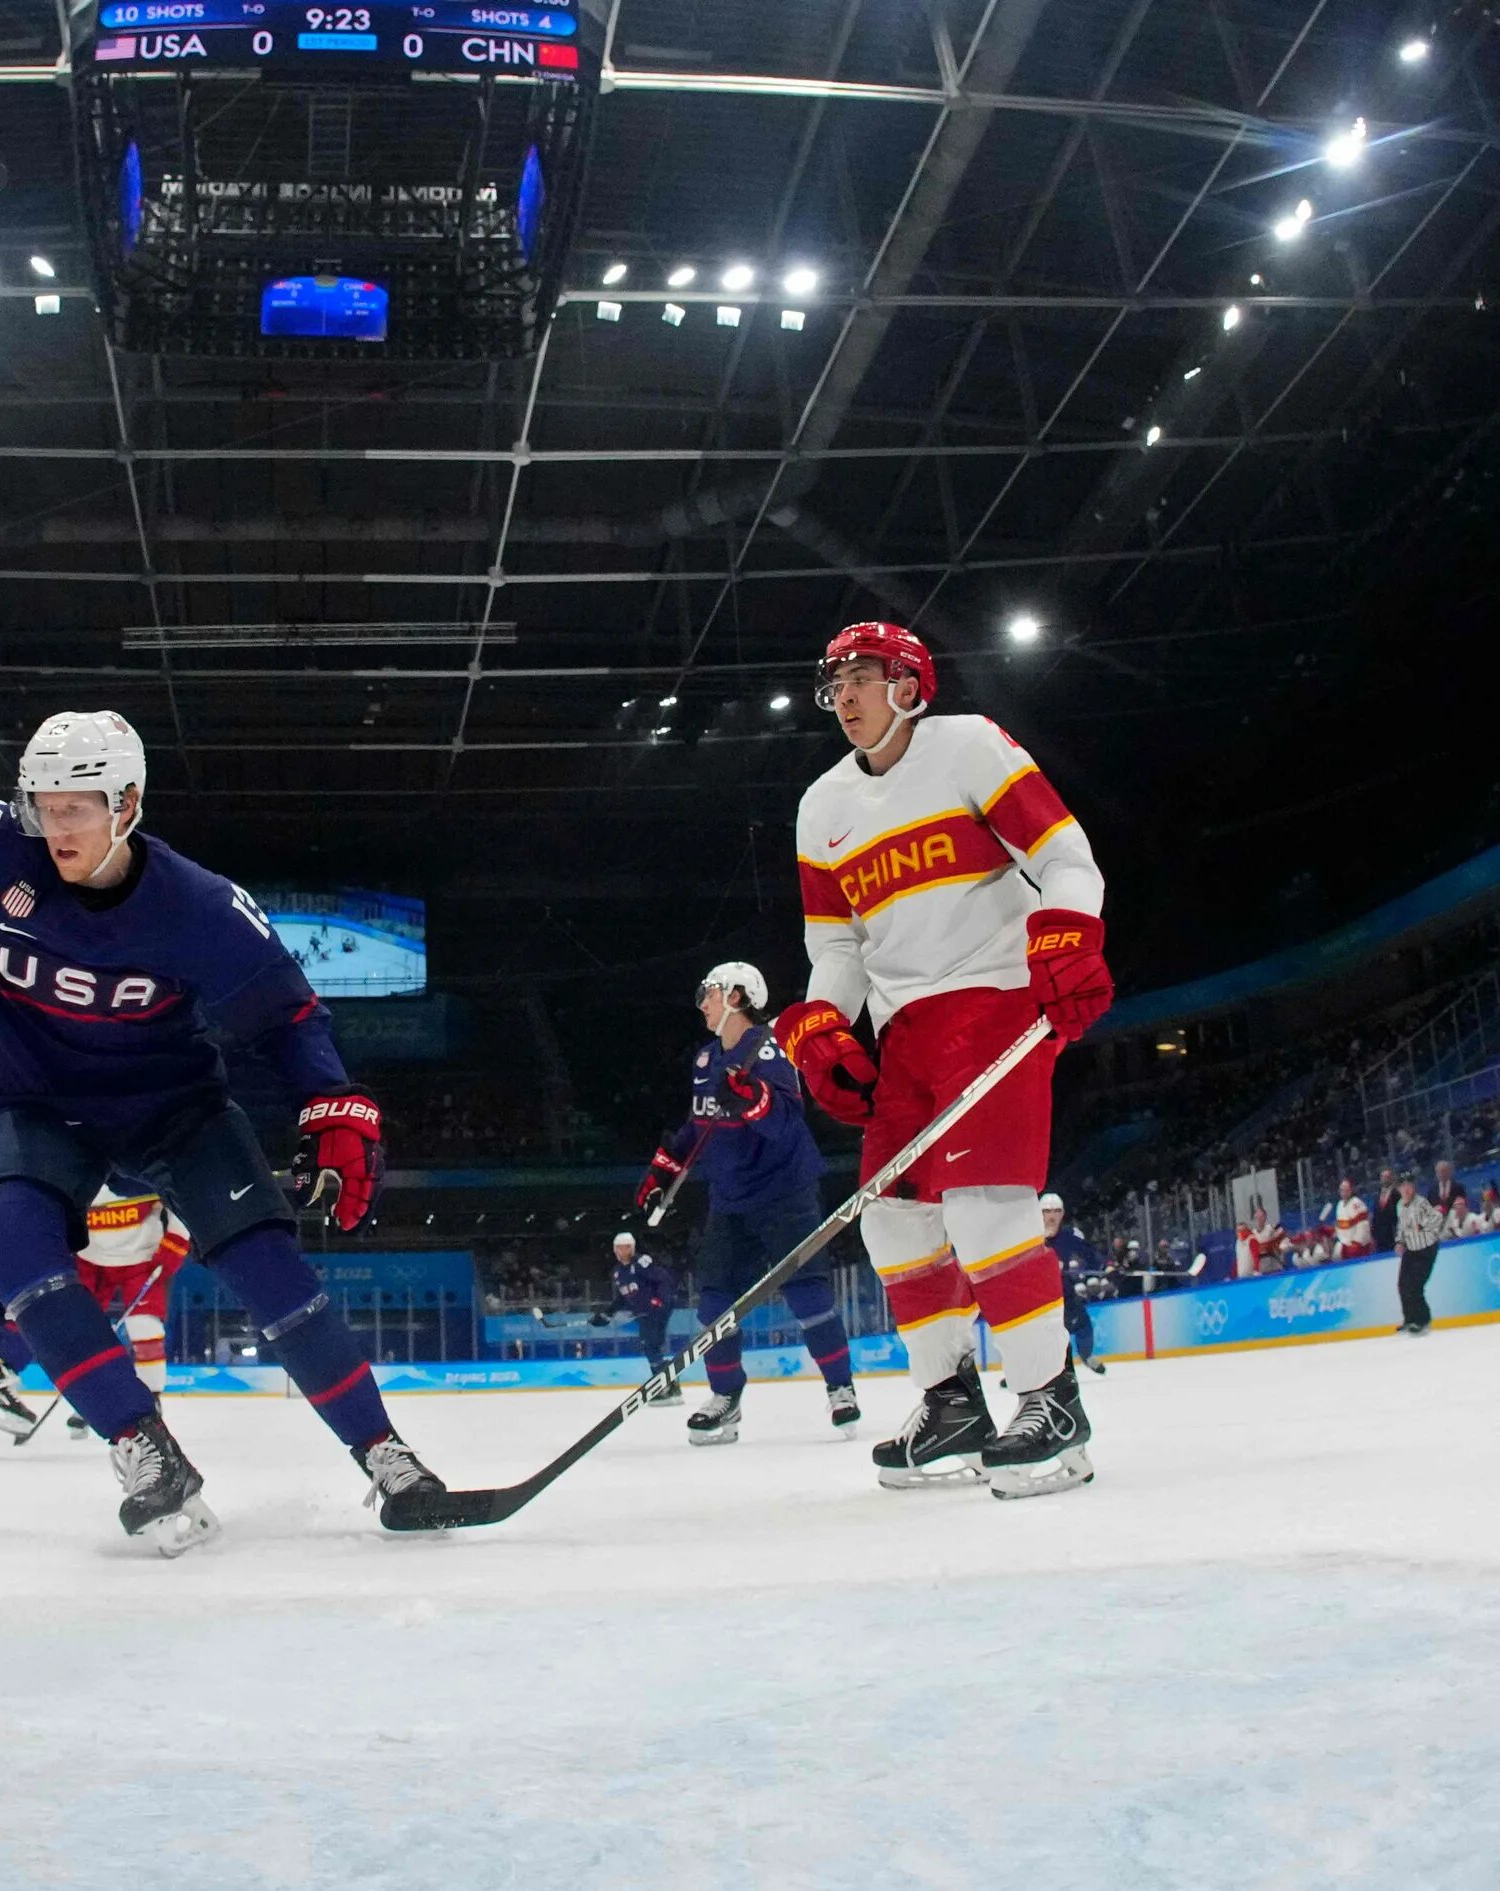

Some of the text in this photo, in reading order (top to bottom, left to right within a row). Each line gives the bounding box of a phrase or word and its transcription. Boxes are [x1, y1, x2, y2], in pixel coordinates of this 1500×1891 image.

[114, 4, 204, 22] 10 SHOTS
[305, 8, 371, 31] 9:23
[471, 9, 552, 29] SHOTS 4
[140, 34, 207, 60] USA
[252, 31, 273, 55] 0
[403, 34, 424, 58] 0
[461, 37, 534, 65] CHN
[840, 832, 957, 907] CHINA
[18, 880, 36, 897] USA
[1027, 932, 1082, 955] UER
[298, 1102, 380, 1126] BAUER
